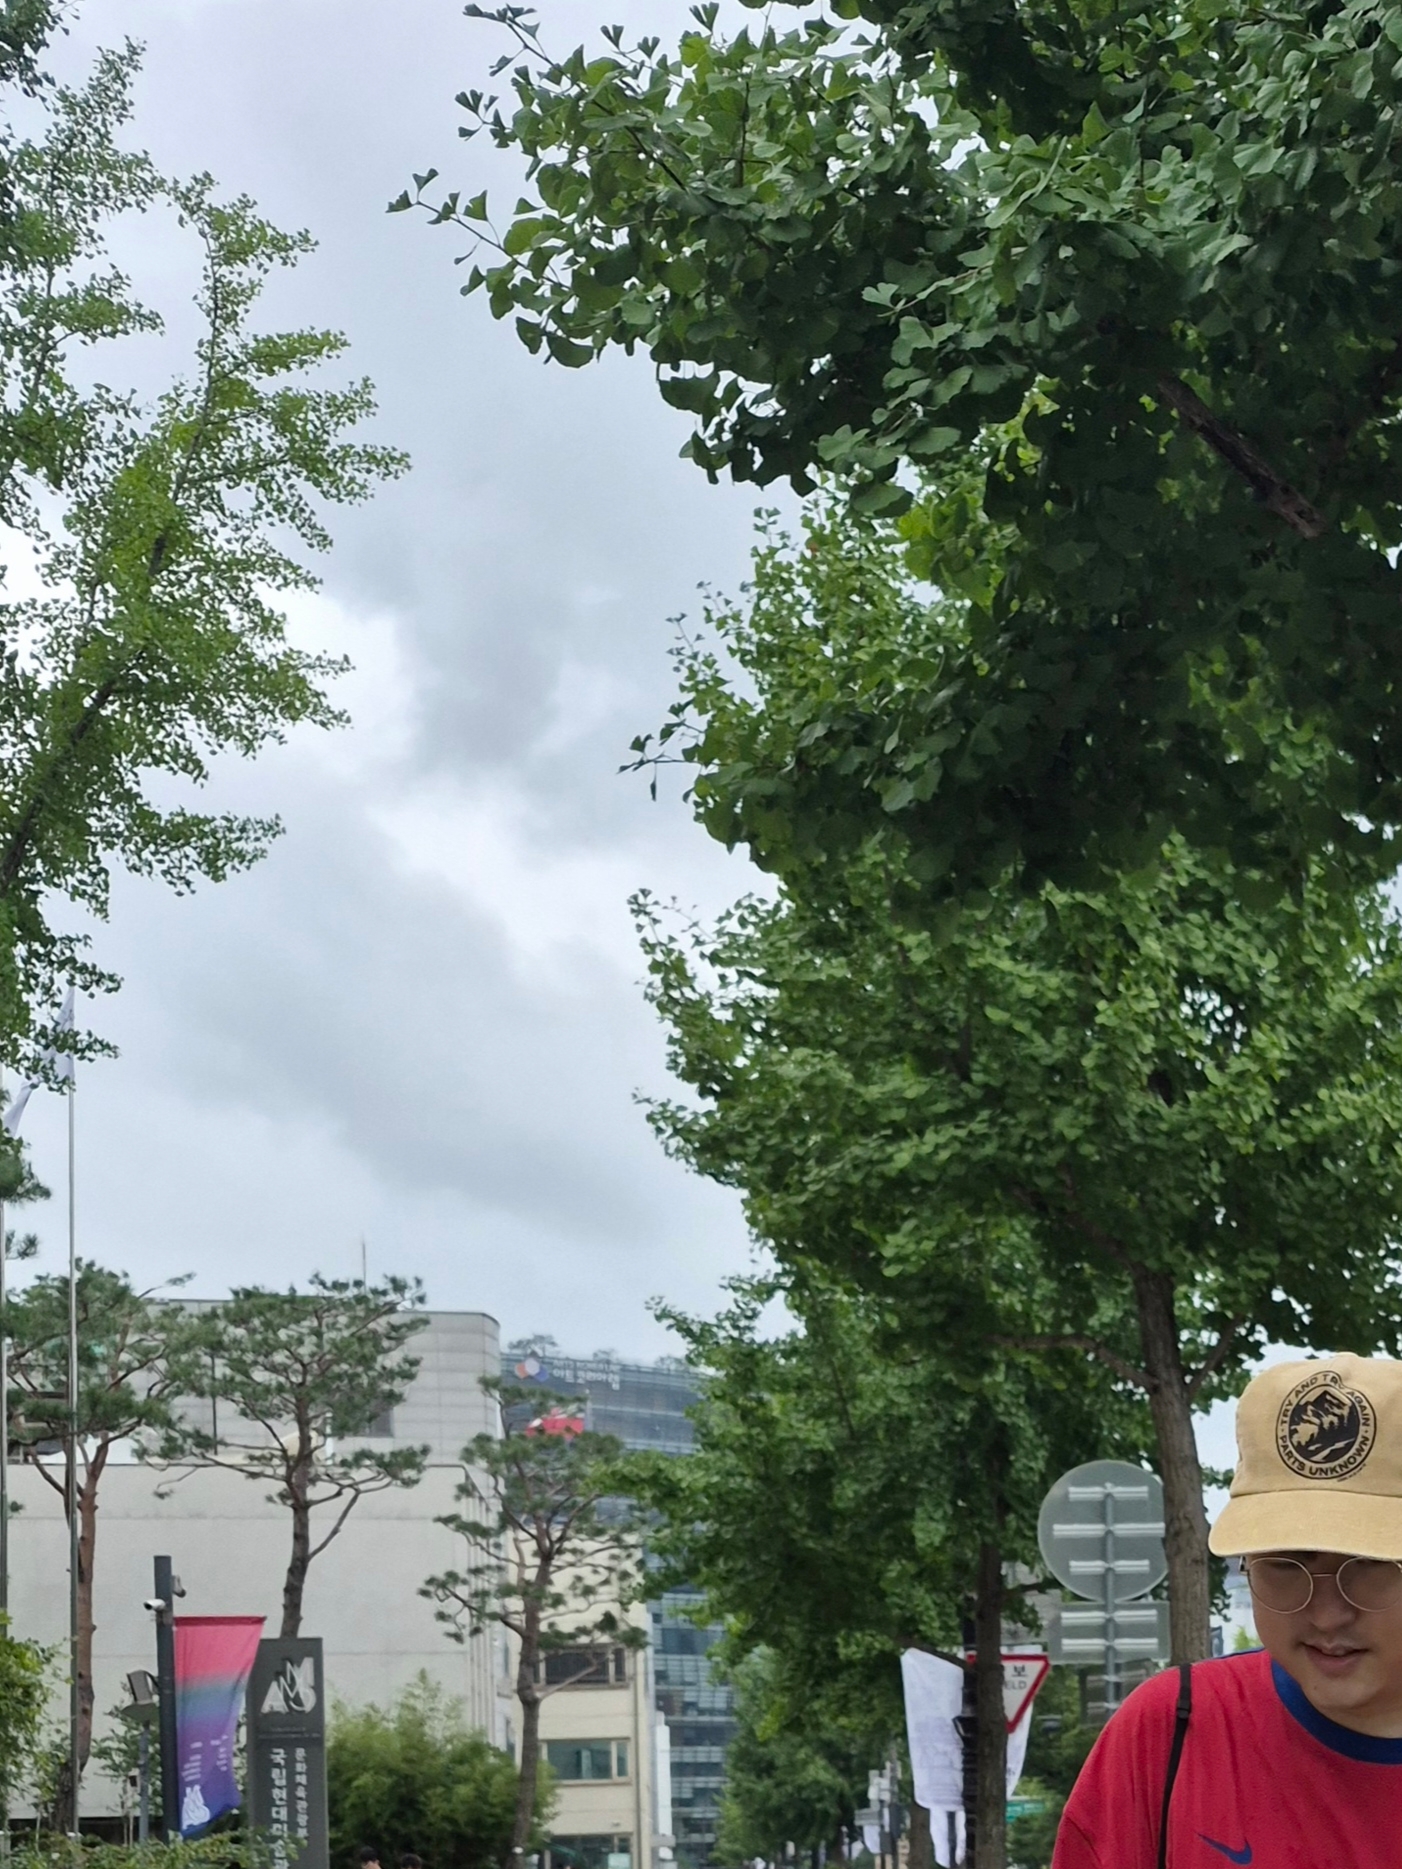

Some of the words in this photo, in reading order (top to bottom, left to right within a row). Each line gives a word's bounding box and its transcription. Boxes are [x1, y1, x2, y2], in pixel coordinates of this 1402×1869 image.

[1280, 1399, 1294, 1426] TRY
[1294, 1376, 1319, 1398] AND
[1346, 1391, 1371, 1427] AGAIN
[1279, 1434, 1306, 1471] PARTS
[1308, 1435, 1370, 1476] UNKNOWN
